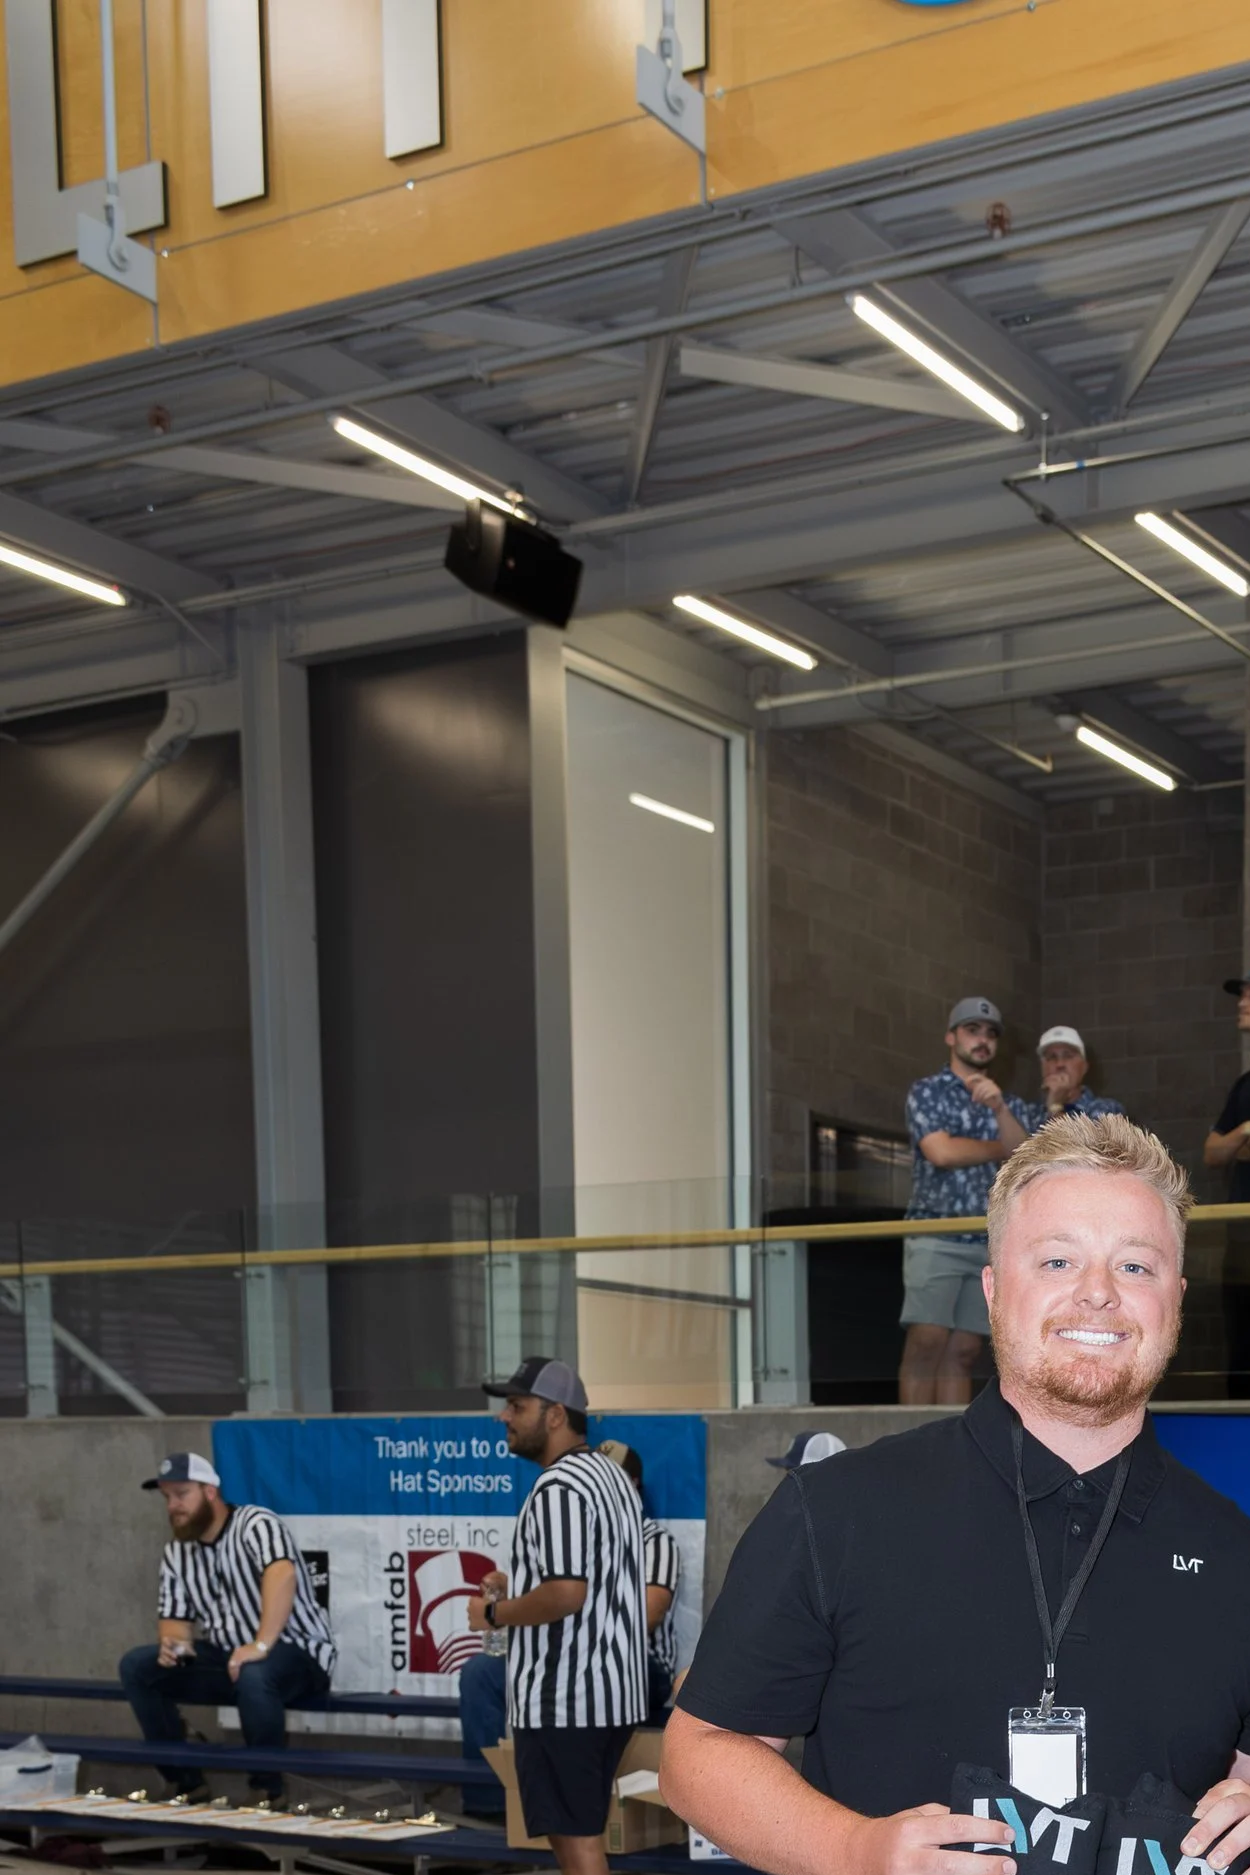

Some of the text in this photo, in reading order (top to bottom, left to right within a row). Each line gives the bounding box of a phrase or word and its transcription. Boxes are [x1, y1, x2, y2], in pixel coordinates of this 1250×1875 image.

[374, 1436, 429, 1459] Thank
[433, 1439, 466, 1464] you
[471, 1436, 491, 1459] to
[390, 1468, 513, 1498] Hat Sponsors
[407, 1521, 500, 1548] steel, inc
[1172, 1553, 1204, 1574] LVT
[383, 1551, 407, 1672] amfab
